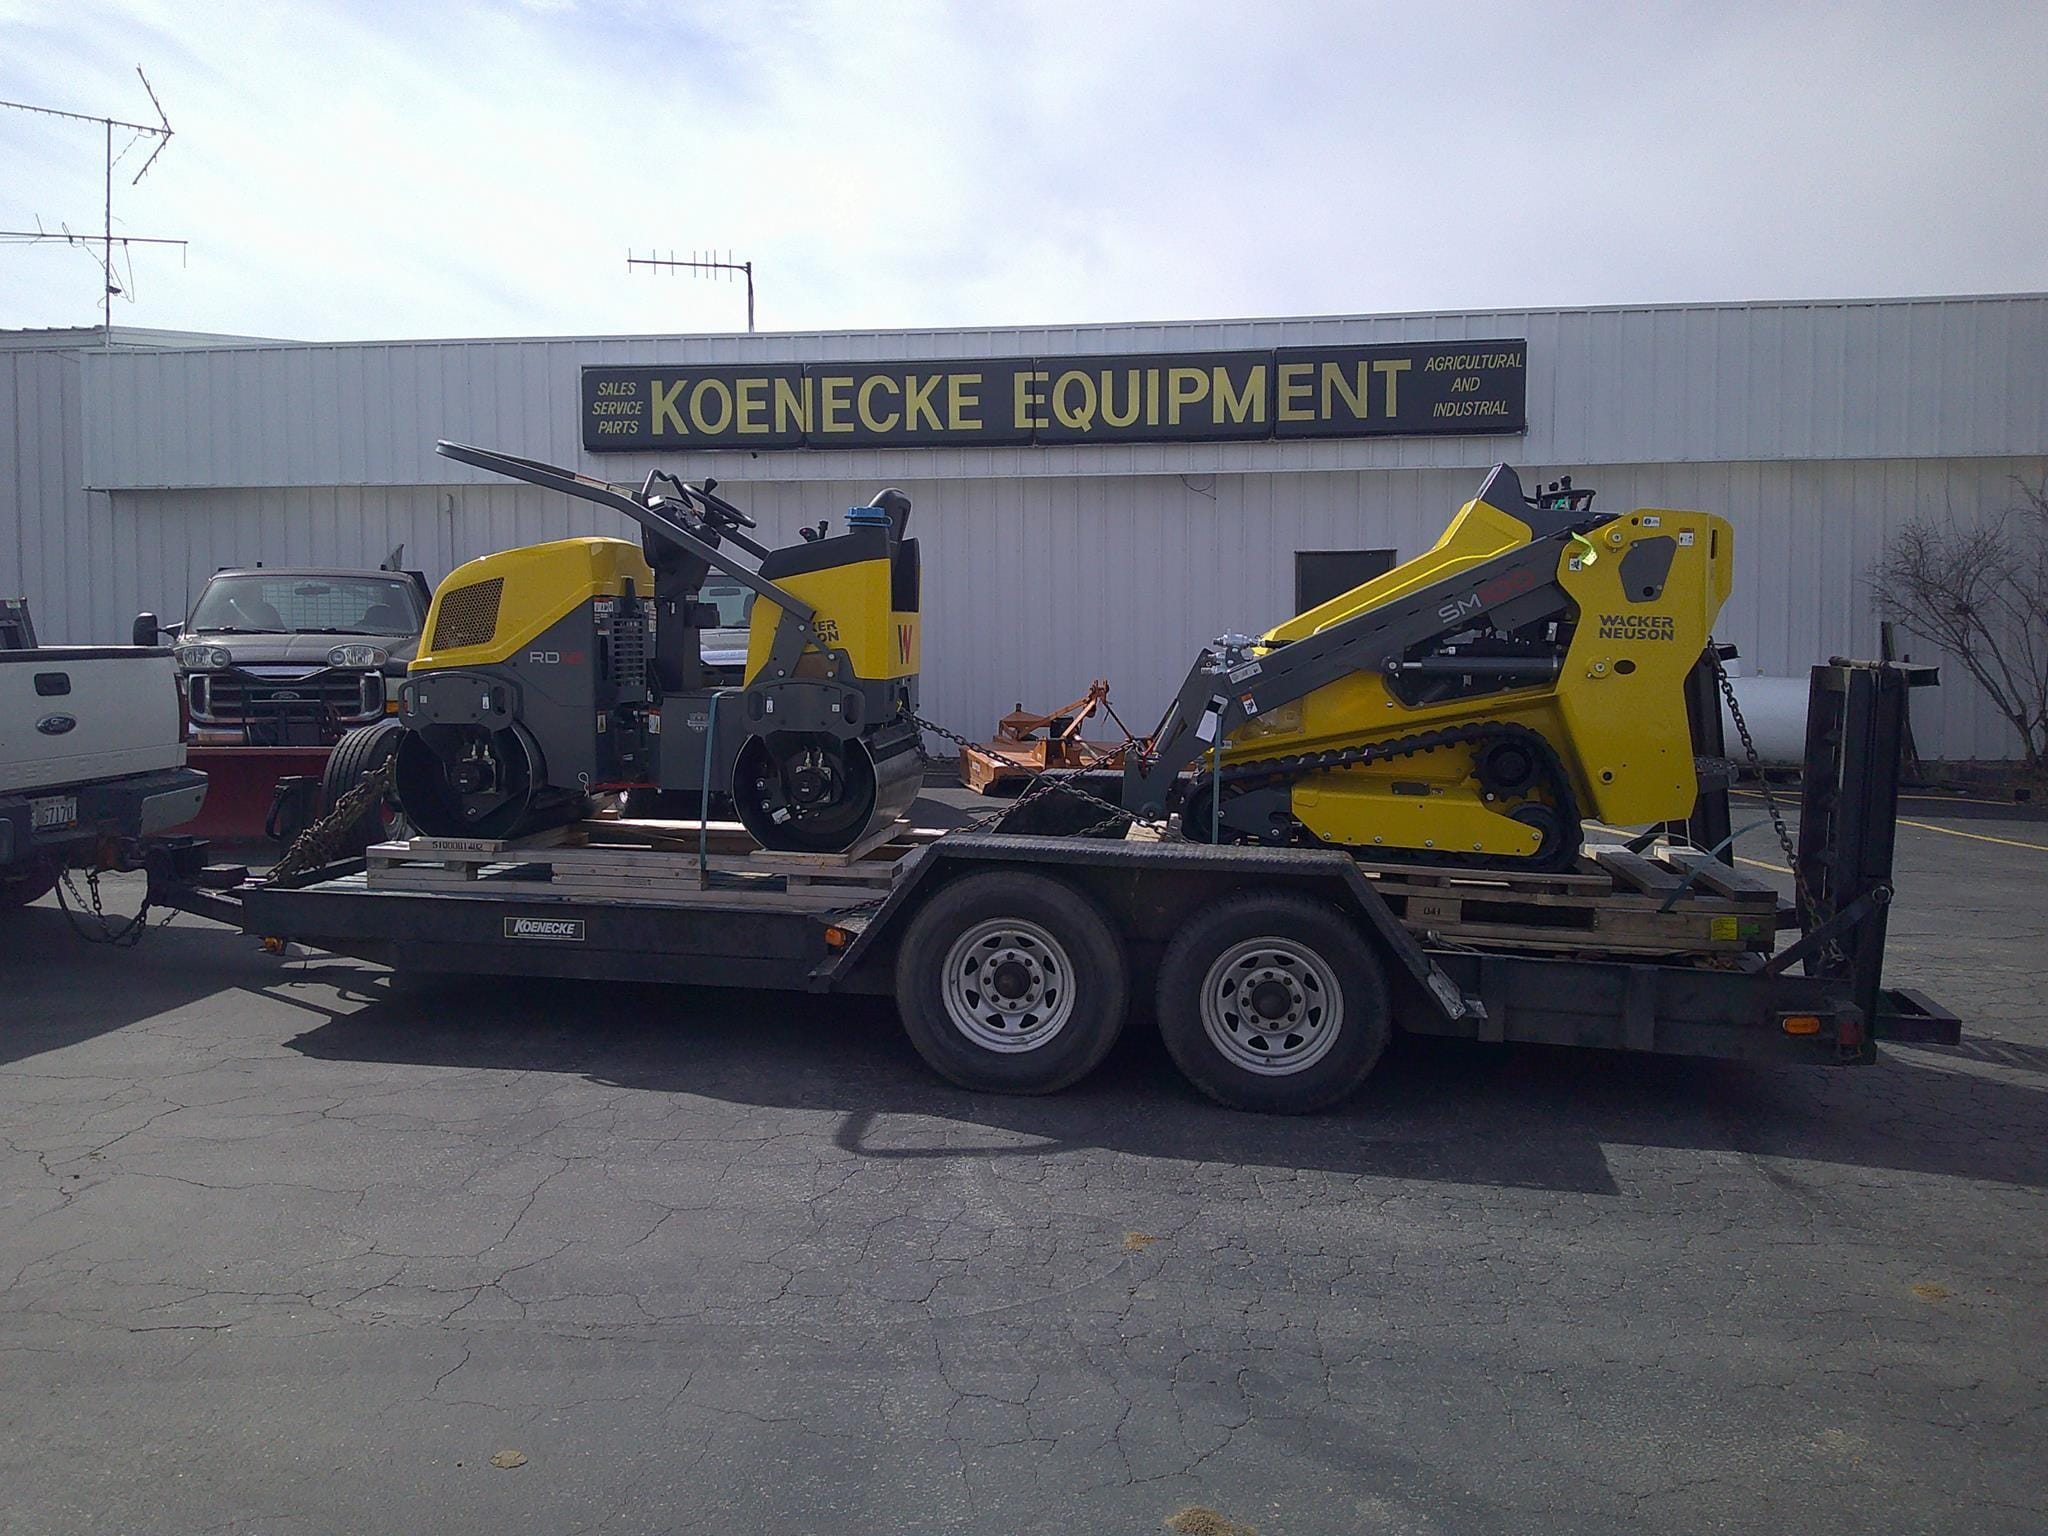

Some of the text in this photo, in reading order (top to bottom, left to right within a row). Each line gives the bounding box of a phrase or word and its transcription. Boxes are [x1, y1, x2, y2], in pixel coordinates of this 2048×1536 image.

[1424, 352, 1523, 372] AGRICULTURAL
[597, 381, 636, 396] SALES
[1450, 376, 1481, 393] AND
[651, 360, 1412, 434] KOENECKE EQUIPMENT
[592, 400, 644, 416] SERVICE
[1432, 399, 1510, 417] INDUSTRIAL
[598, 419, 640, 435] PARTS
[1599, 614, 1674, 629] WACKER
[1599, 627, 1674, 641] NEUSON
[514, 919, 575, 934] KOENECKE
